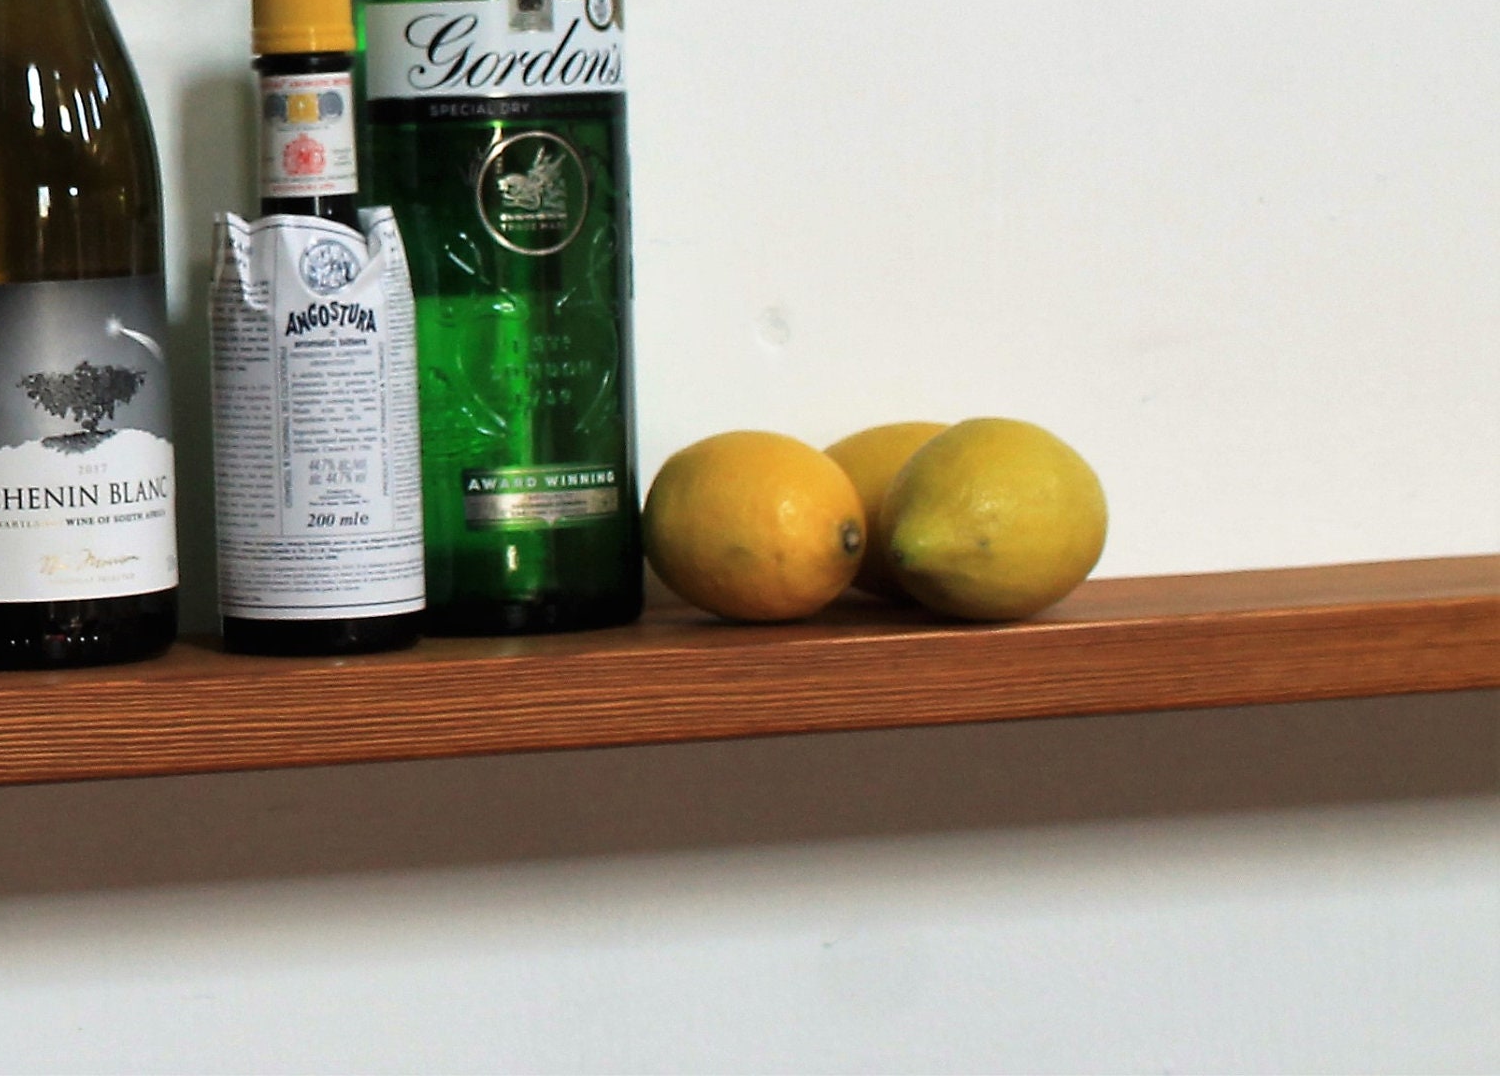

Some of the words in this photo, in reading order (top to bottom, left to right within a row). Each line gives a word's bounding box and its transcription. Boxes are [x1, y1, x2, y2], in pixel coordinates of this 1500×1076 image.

[405, 13, 622, 90] Gordon's
[429, 103, 497, 117] SPECIAL
[498, 101, 531, 115] DRY
[284, 301, 378, 337] ANGOSTURA
[108, 475, 168, 505] BLANC
[467, 477, 538, 492] AWARD
[545, 471, 616, 486] WINNING
[65, 517, 94, 527] WINE
[97, 515, 111, 525] OF
[114, 512, 143, 524] SOUTH
[307, 513, 336, 528] 200
